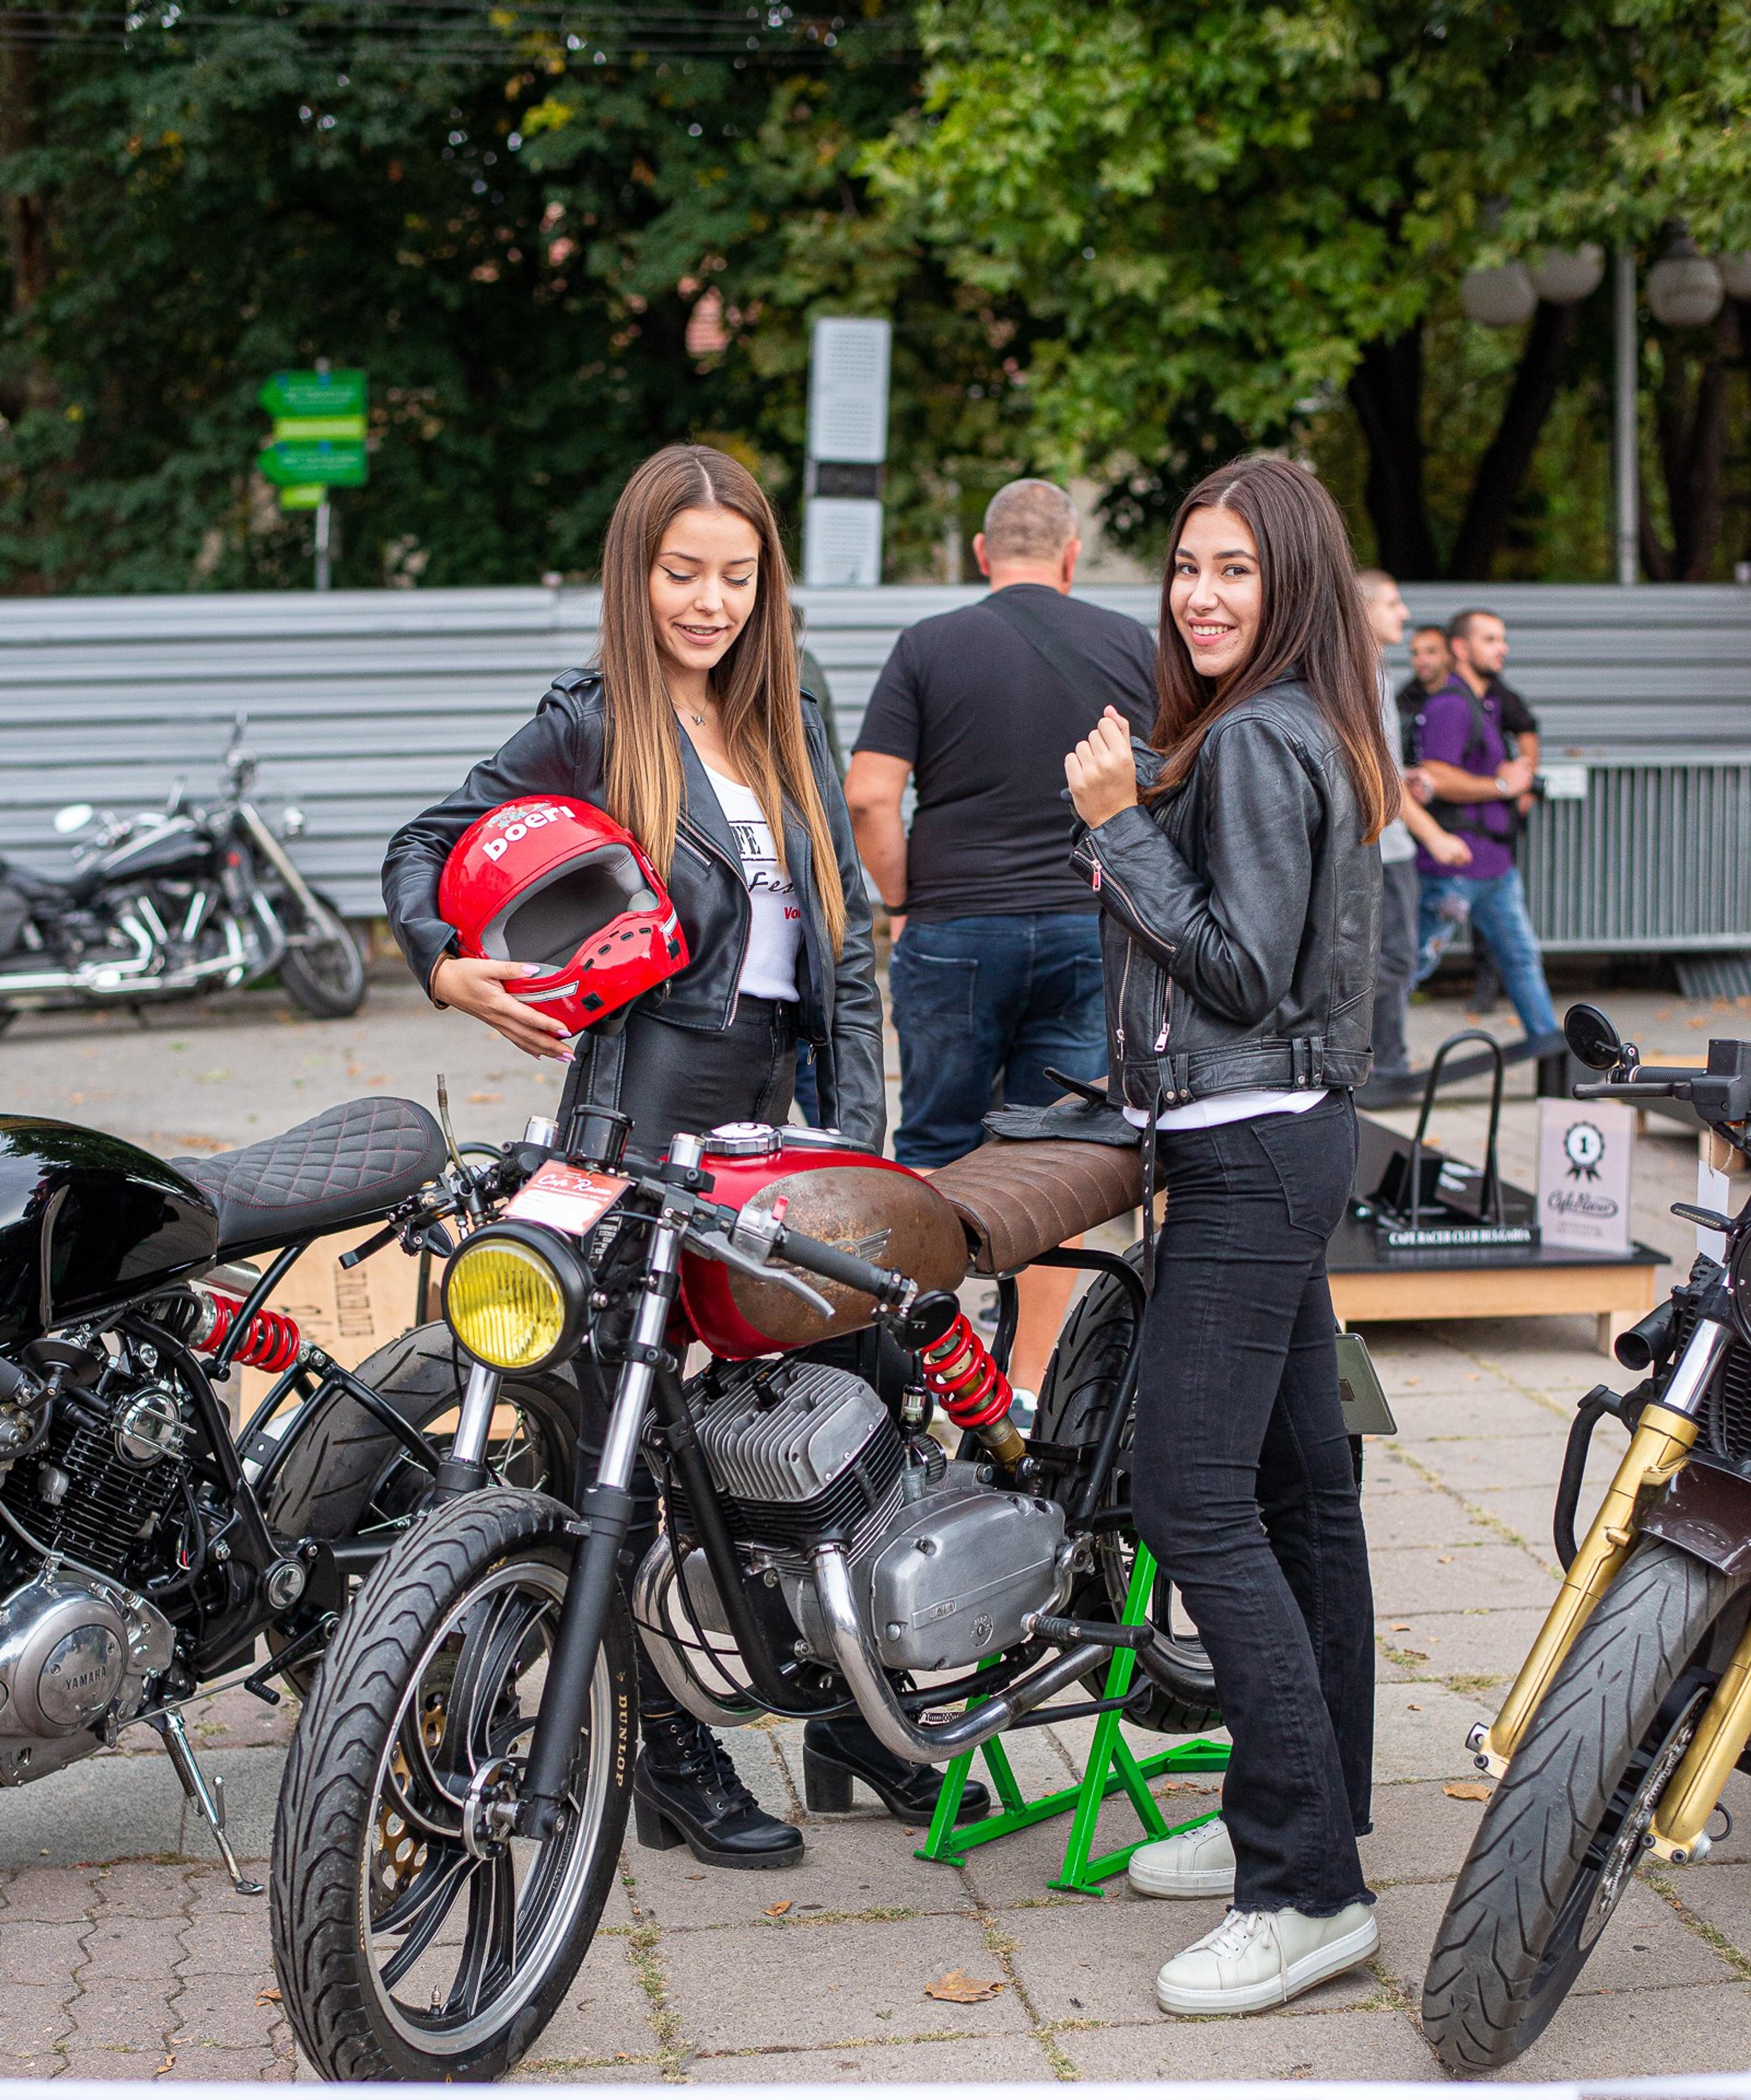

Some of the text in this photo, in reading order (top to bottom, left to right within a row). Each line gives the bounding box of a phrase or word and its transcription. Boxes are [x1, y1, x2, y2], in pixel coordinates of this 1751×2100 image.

[482, 806, 576, 861] boeri
[730, 825, 762, 855] FE
[747, 871, 795, 894] Fes
[1580, 1136, 1588, 1154] 1
[65, 1665, 106, 1690] YAMAHA
[616, 1695, 628, 1787] DUNLOP
